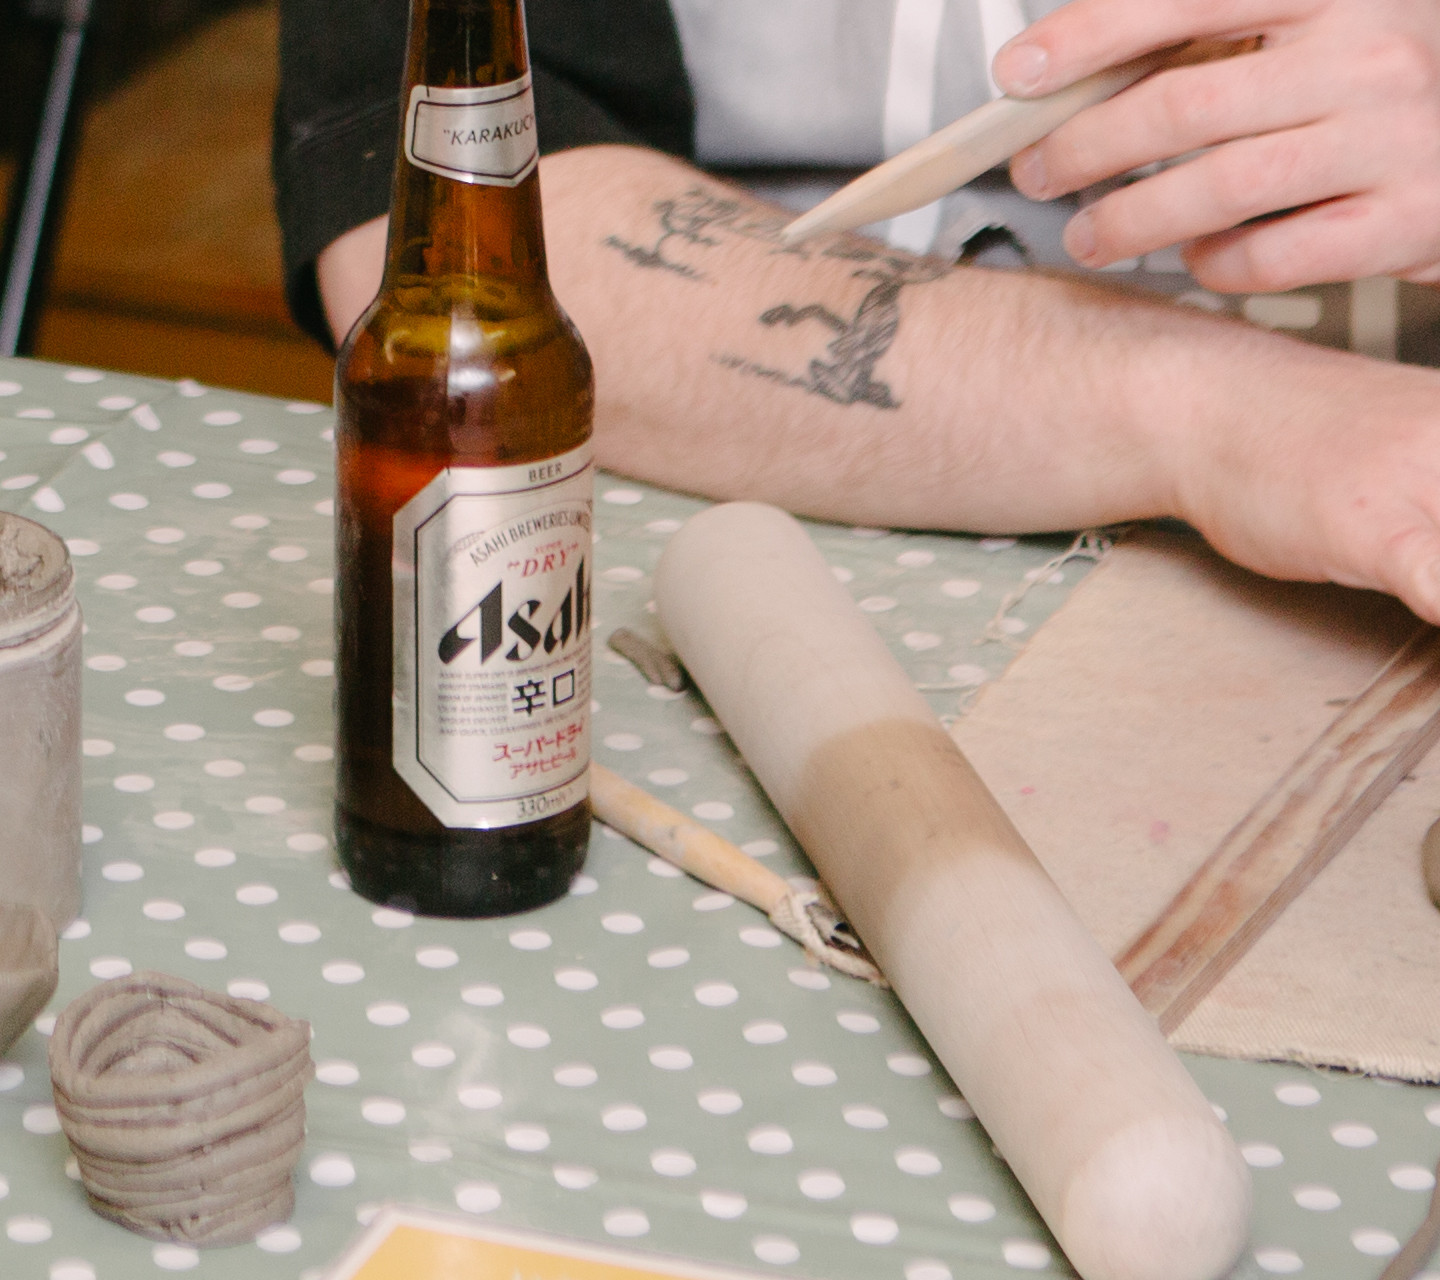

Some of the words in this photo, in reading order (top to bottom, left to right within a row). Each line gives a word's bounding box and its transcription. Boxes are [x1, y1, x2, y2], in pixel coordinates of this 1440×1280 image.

[528, 462, 563, 483] BEER
[469, 531, 510, 567] ASAHI
[512, 669, 576, 716] 辛口
